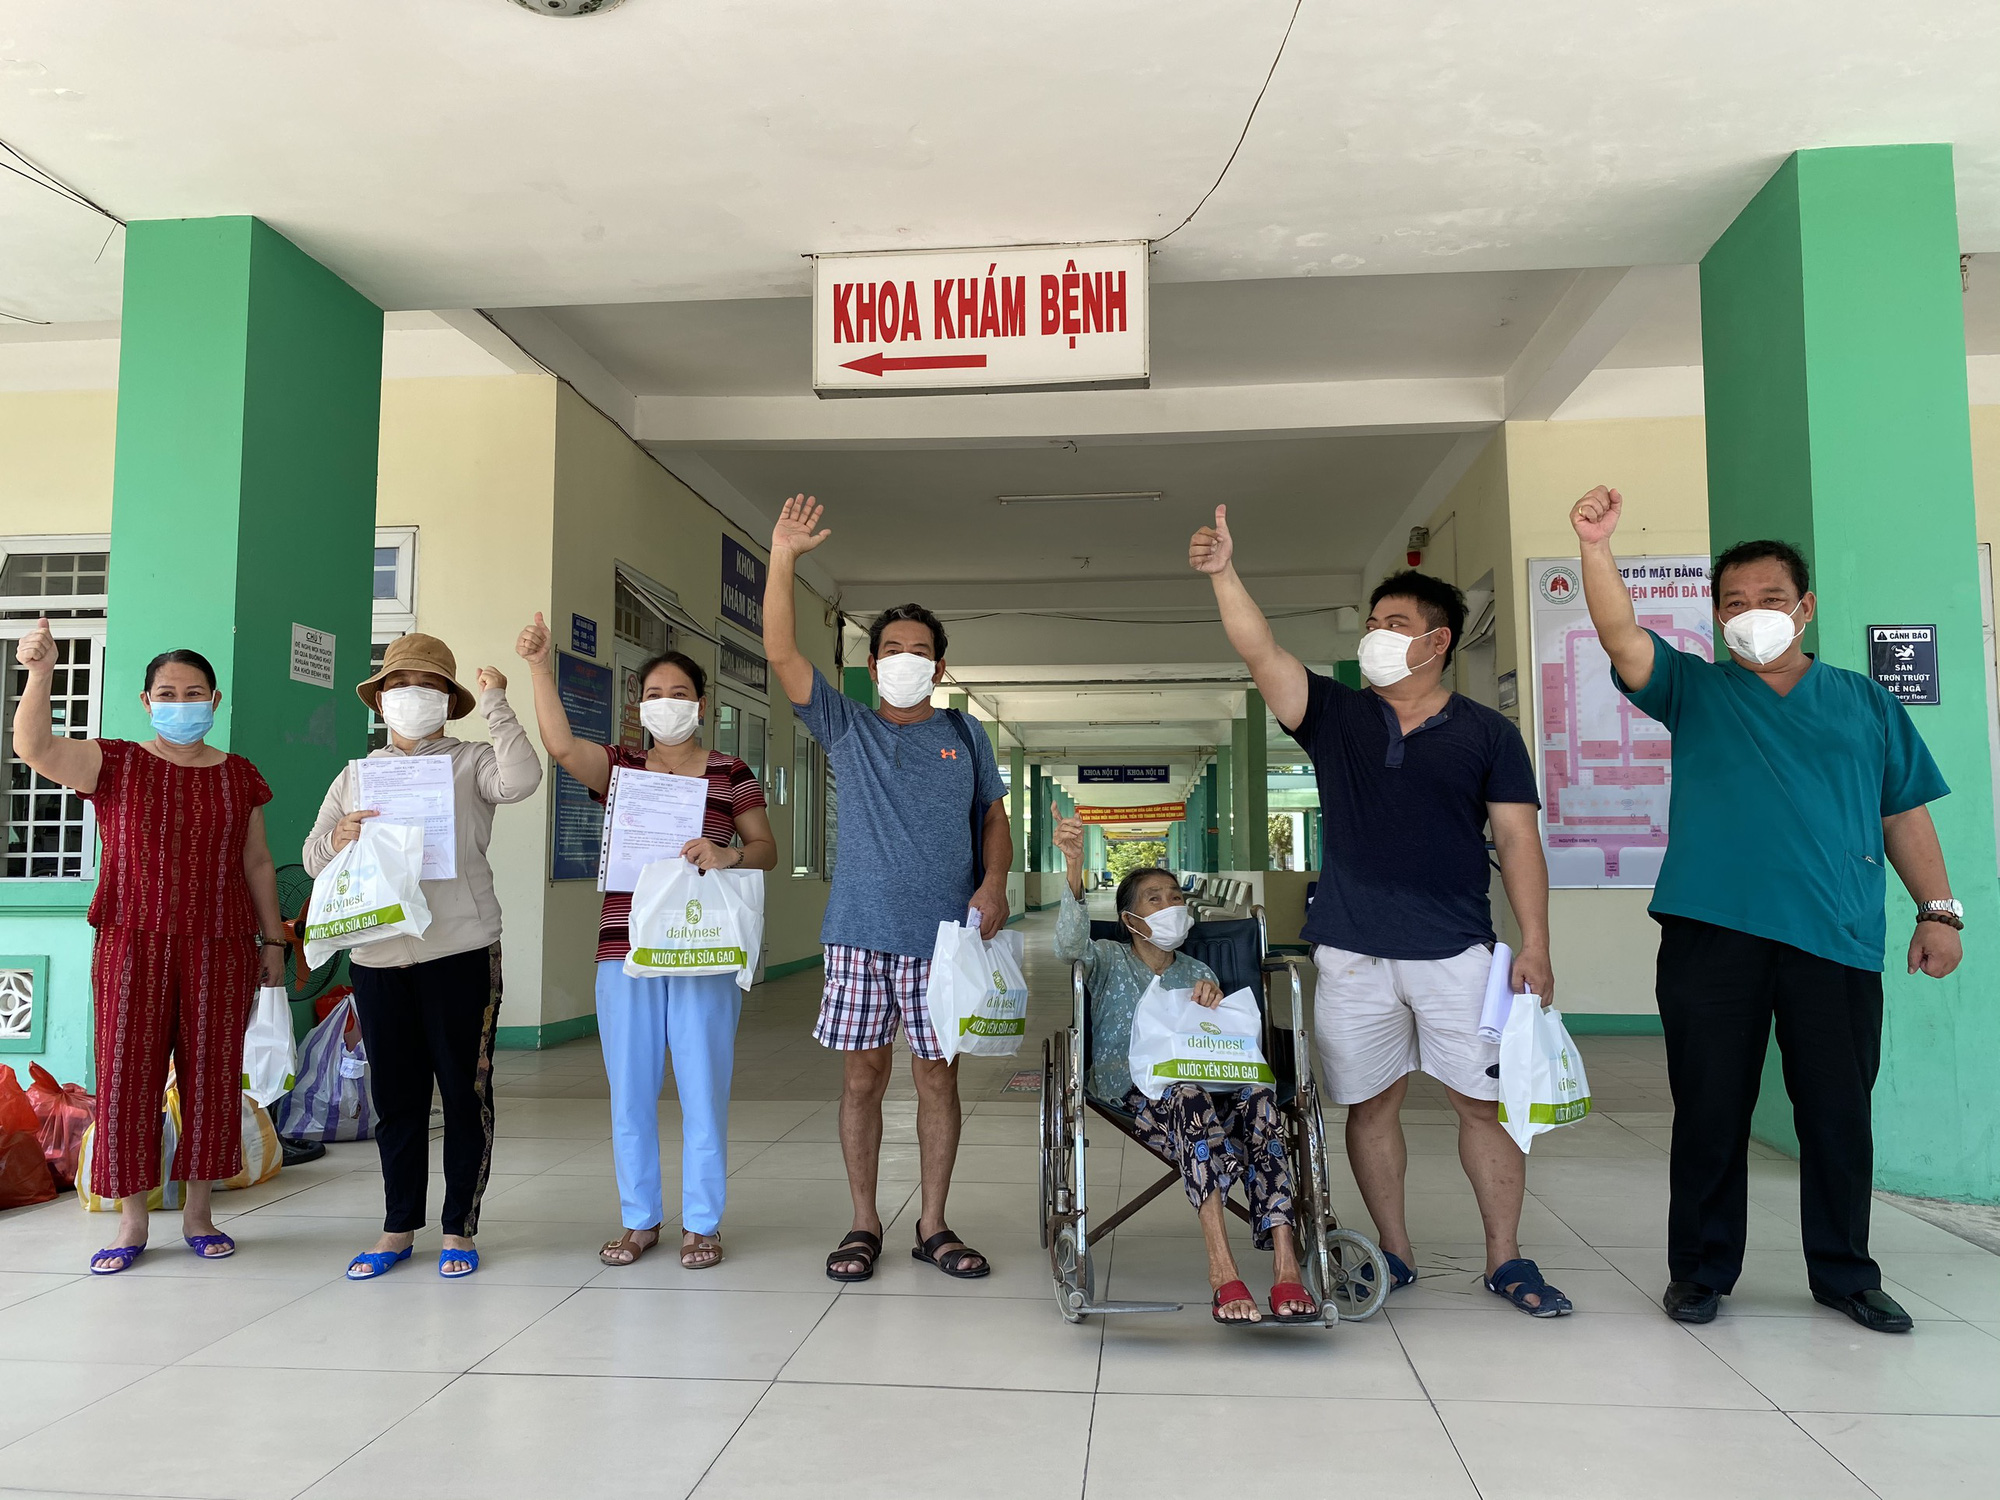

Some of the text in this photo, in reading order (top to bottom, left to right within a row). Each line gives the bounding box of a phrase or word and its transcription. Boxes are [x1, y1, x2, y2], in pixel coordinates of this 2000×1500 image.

[833, 259, 1127, 349] KHOA KHÁM BỆNH
[736, 549, 756, 584] KHOA
[1632, 565, 1647, 578] ĐỒ
[1649, 566, 1672, 580] MẶT
[1674, 564, 1703, 578] BẰNG
[1651, 583, 1678, 598] PHỔI
[1682, 583, 1701, 598] ĐÀ
[723, 584, 763, 627] KHÁM BỆN
[306, 631, 318, 642] CHÚ
[1889, 630, 1928, 640] CẢNH BÁO
[1894, 662, 1913, 671] SÀN
[1878, 673, 1930, 683] TRƠN TRƯỢT
[1888, 682, 1921, 693] DỄ NGÃ
[1102, 768, 1113, 777] NỘI
[1145, 768, 1157, 777] NỘI
[651, 949, 676, 965] NƯỚC
[678, 949, 695, 965] YẾN
[697, 949, 715, 964] SỮA
[1187, 1034, 1245, 1053] dailynest
[1177, 1061, 1202, 1077] NƯỚC
[1203, 1061, 1220, 1078] YẾN
[1222, 1063, 1240, 1079] SỮA
